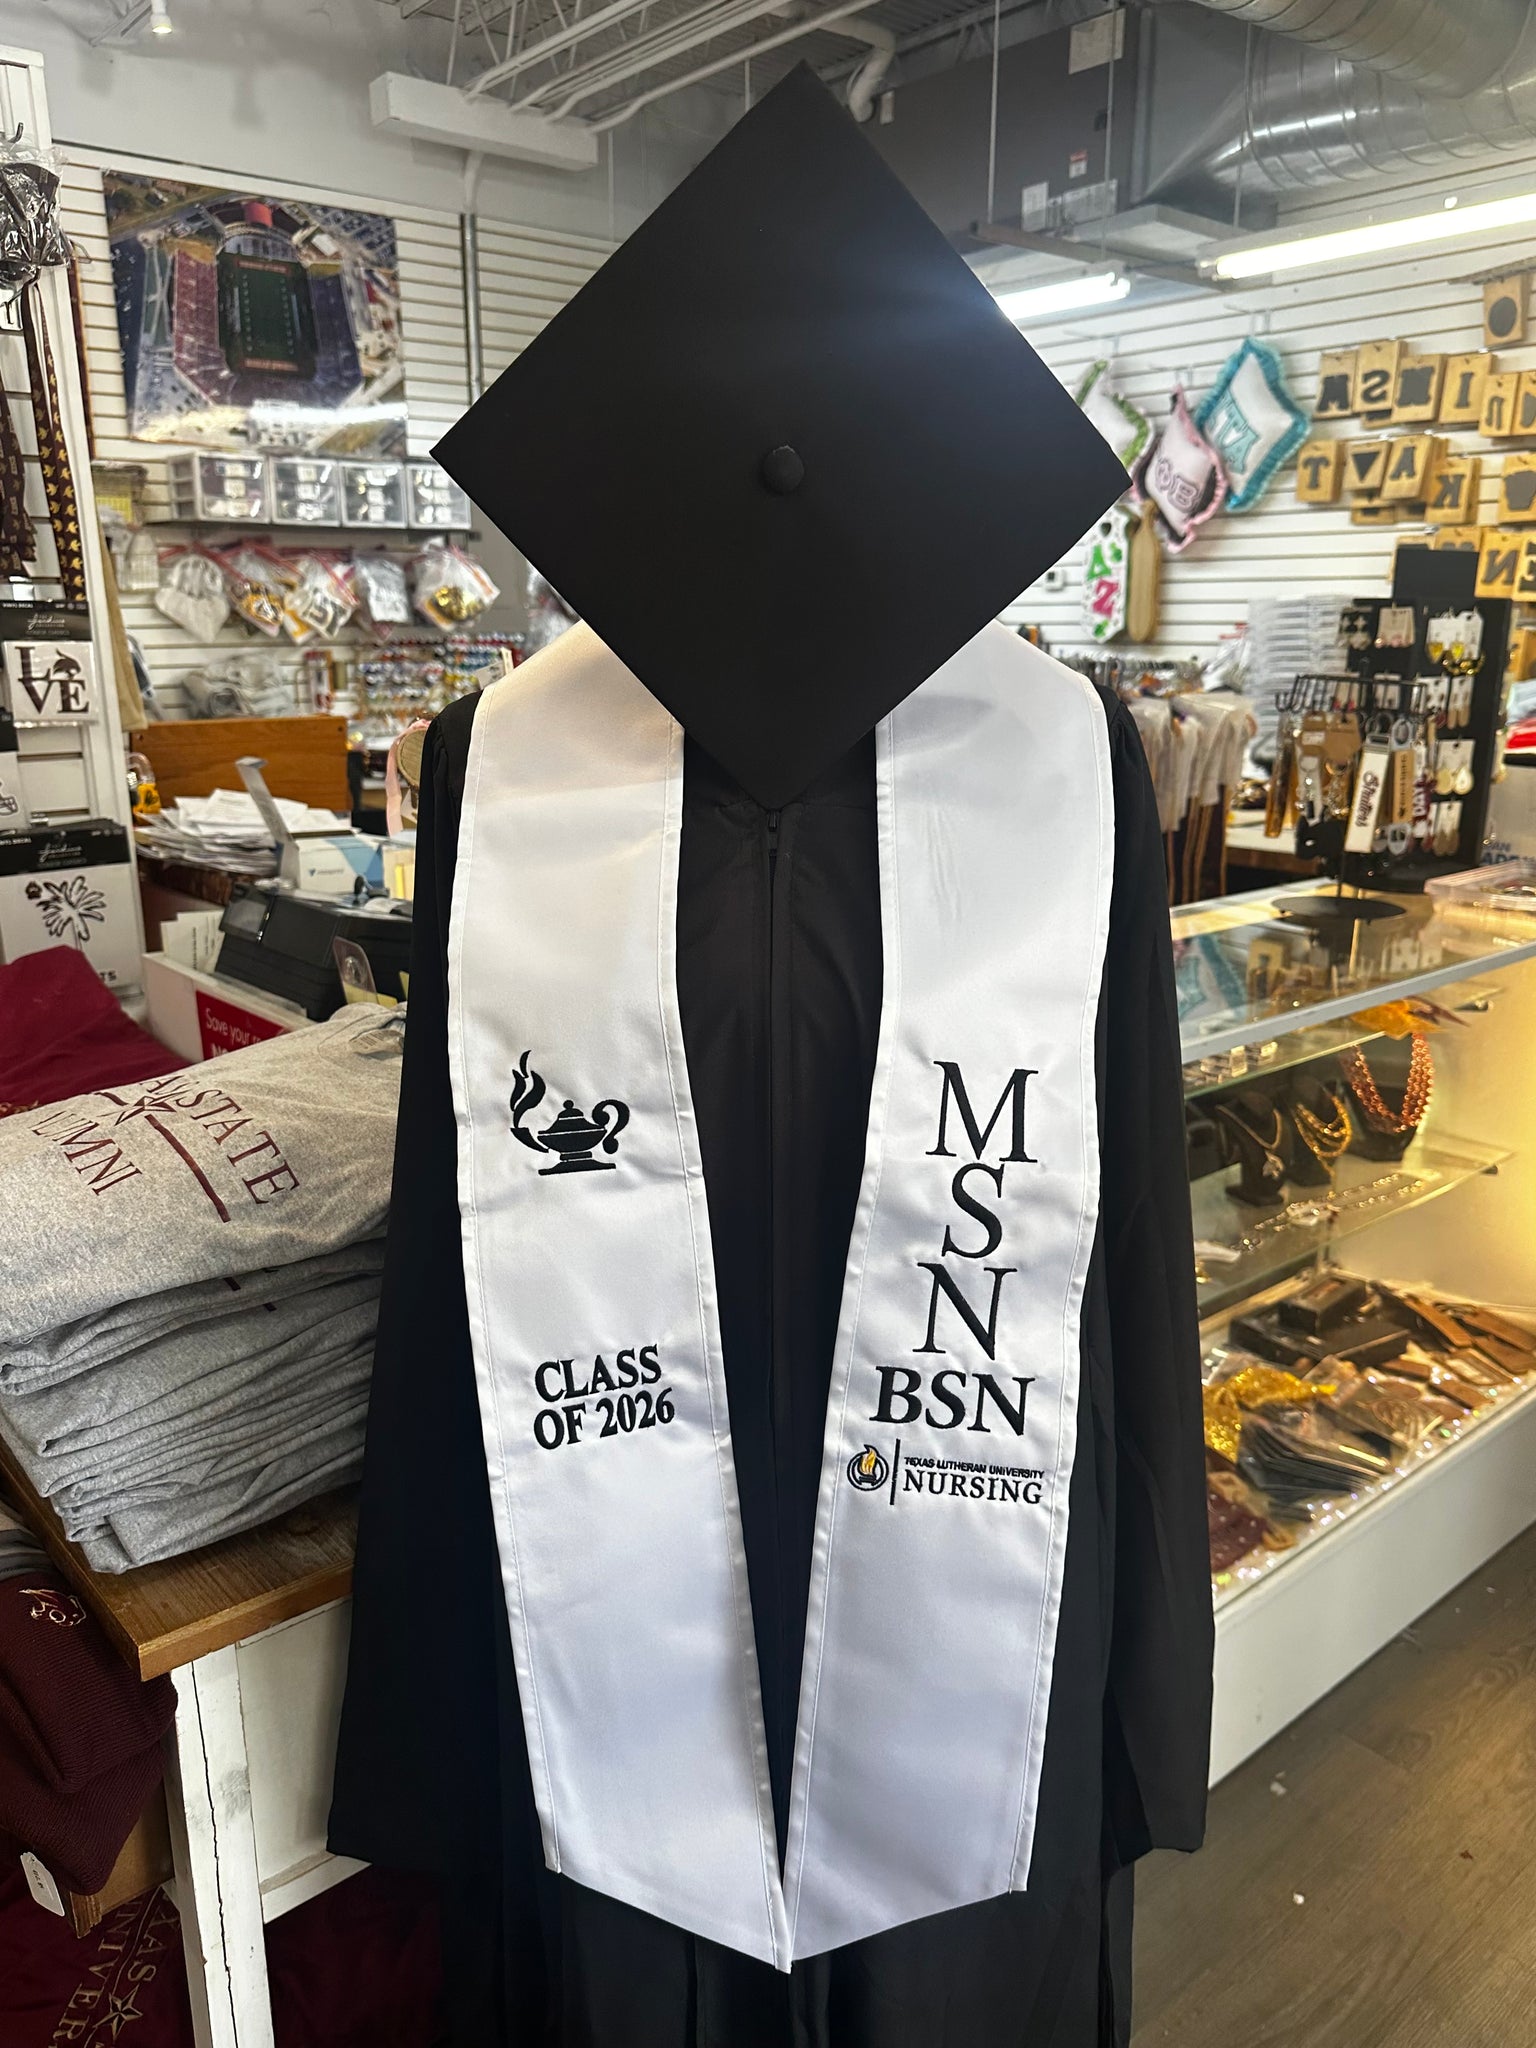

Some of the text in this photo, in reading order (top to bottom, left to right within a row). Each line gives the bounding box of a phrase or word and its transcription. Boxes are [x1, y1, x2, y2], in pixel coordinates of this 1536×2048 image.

[176, 1088, 301, 1205] STATE
[534, 1343, 662, 1403] CLASS
[869, 1365, 1036, 1437] BSN
[533, 1387, 675, 1451] OF 2026
[902, 1469, 1044, 1505] NURSING
[904, 1456, 1045, 1479] TEXAS LUTHERAN UNIVERSITY
